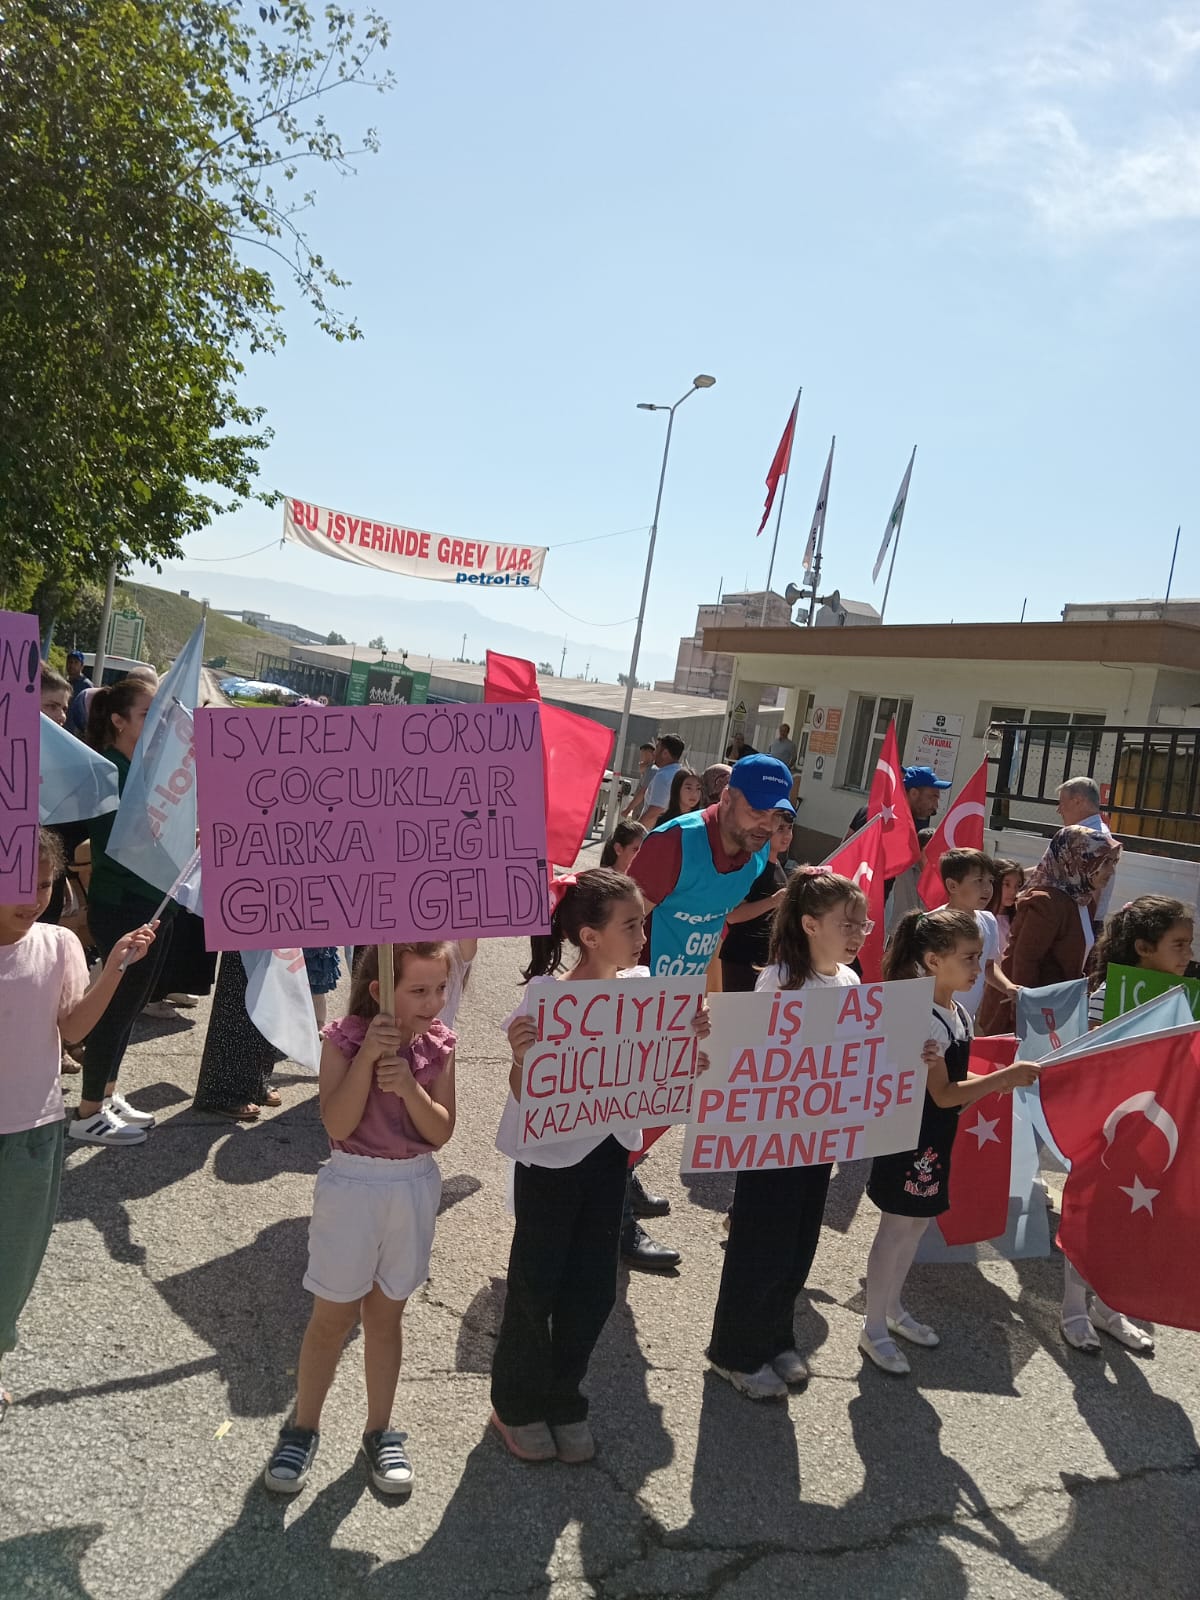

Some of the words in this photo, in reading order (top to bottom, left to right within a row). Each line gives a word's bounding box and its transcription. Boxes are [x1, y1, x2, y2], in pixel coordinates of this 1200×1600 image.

[292, 499, 319, 532] BU
[326, 512, 431, 559] İŞYERİNDE
[437, 537, 489, 569] GREV
[496, 546, 532, 571] VAR.
[208, 711, 382, 762] İŞVEREN
[402, 707, 539, 756] GÖRSÜN
[246, 765, 518, 815] ÇOÇUKLAR
[213, 820, 375, 867] PARKA
[396, 808, 538, 862] DEĞİL
[220, 871, 396, 935] GREVE
[409, 858, 550, 931] GELDİ
[536, 990, 703, 1046] İŞÇİYİZ!
[767, 992, 803, 1045] İŞ
[837, 985, 883, 1030] AŞ
[526, 1035, 698, 1099] GÜÇLÜYÜZ!
[728, 1037, 885, 1084] ADALET
[523, 1081, 694, 1144] KAZANACAĞIZ!
[691, 1125, 865, 1169] EMANET
